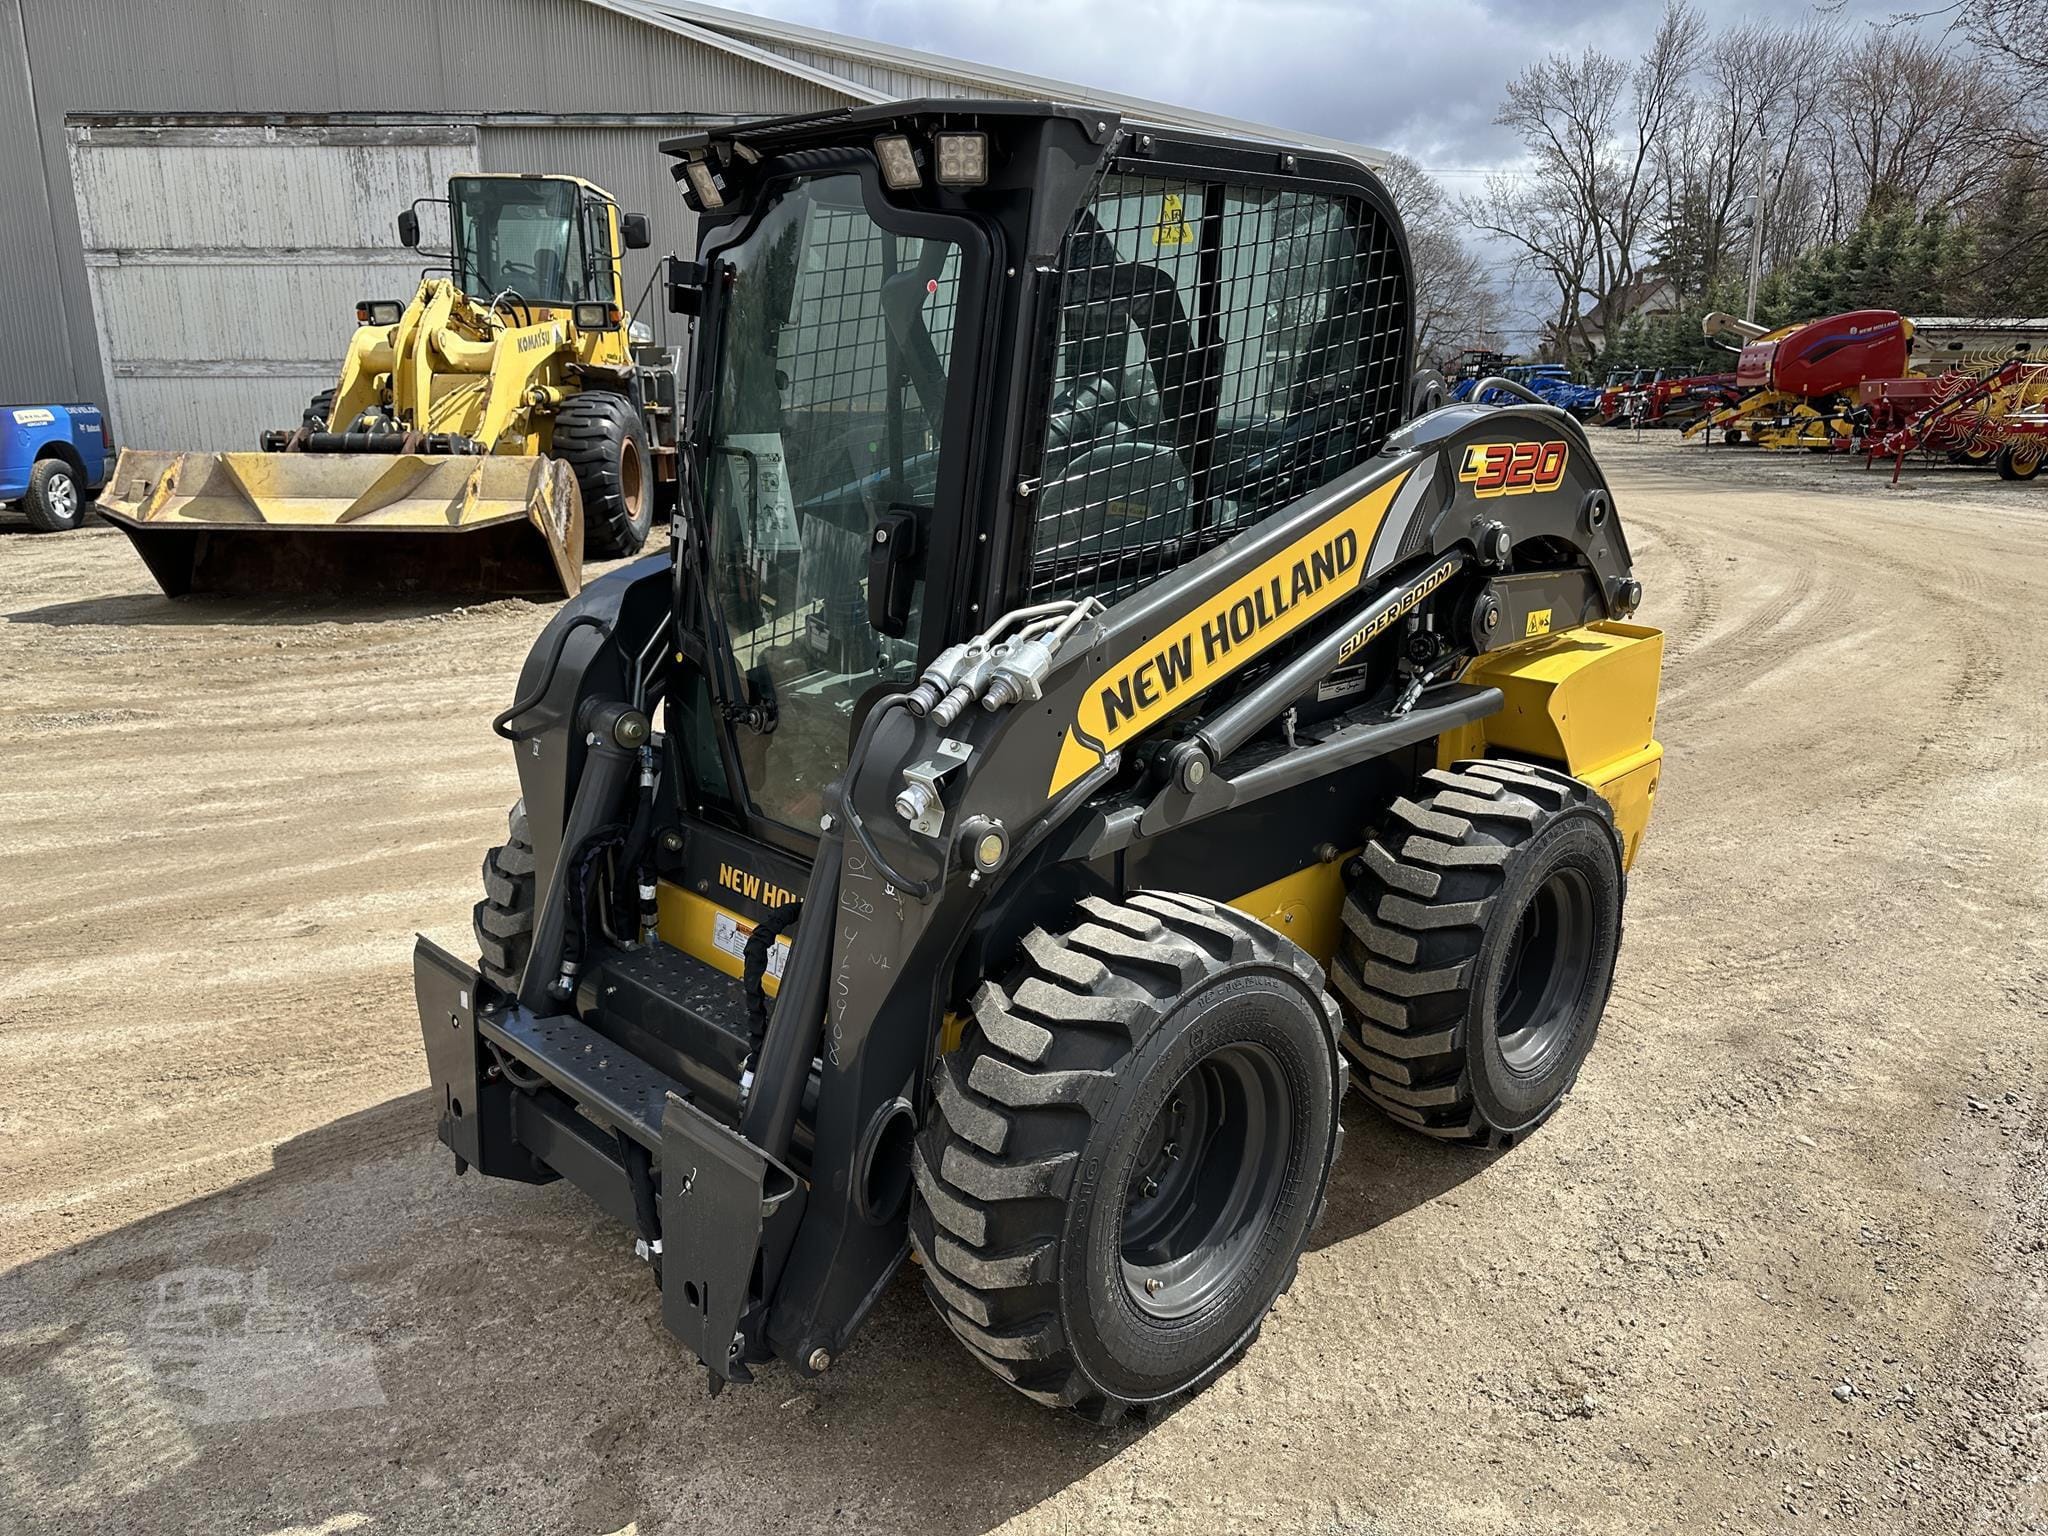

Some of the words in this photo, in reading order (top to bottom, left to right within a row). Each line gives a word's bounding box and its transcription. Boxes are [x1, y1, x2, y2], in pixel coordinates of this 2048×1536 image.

[518, 329, 550, 353] KOMATSU
[1459, 441, 1569, 499] L320
[1100, 632, 1194, 734] NEW
[1201, 528, 1358, 666] HOLLAND
[1338, 602, 1400, 664] SUPER
[1400, 562, 1452, 615] BOOM
[719, 862, 761, 900] NEW
